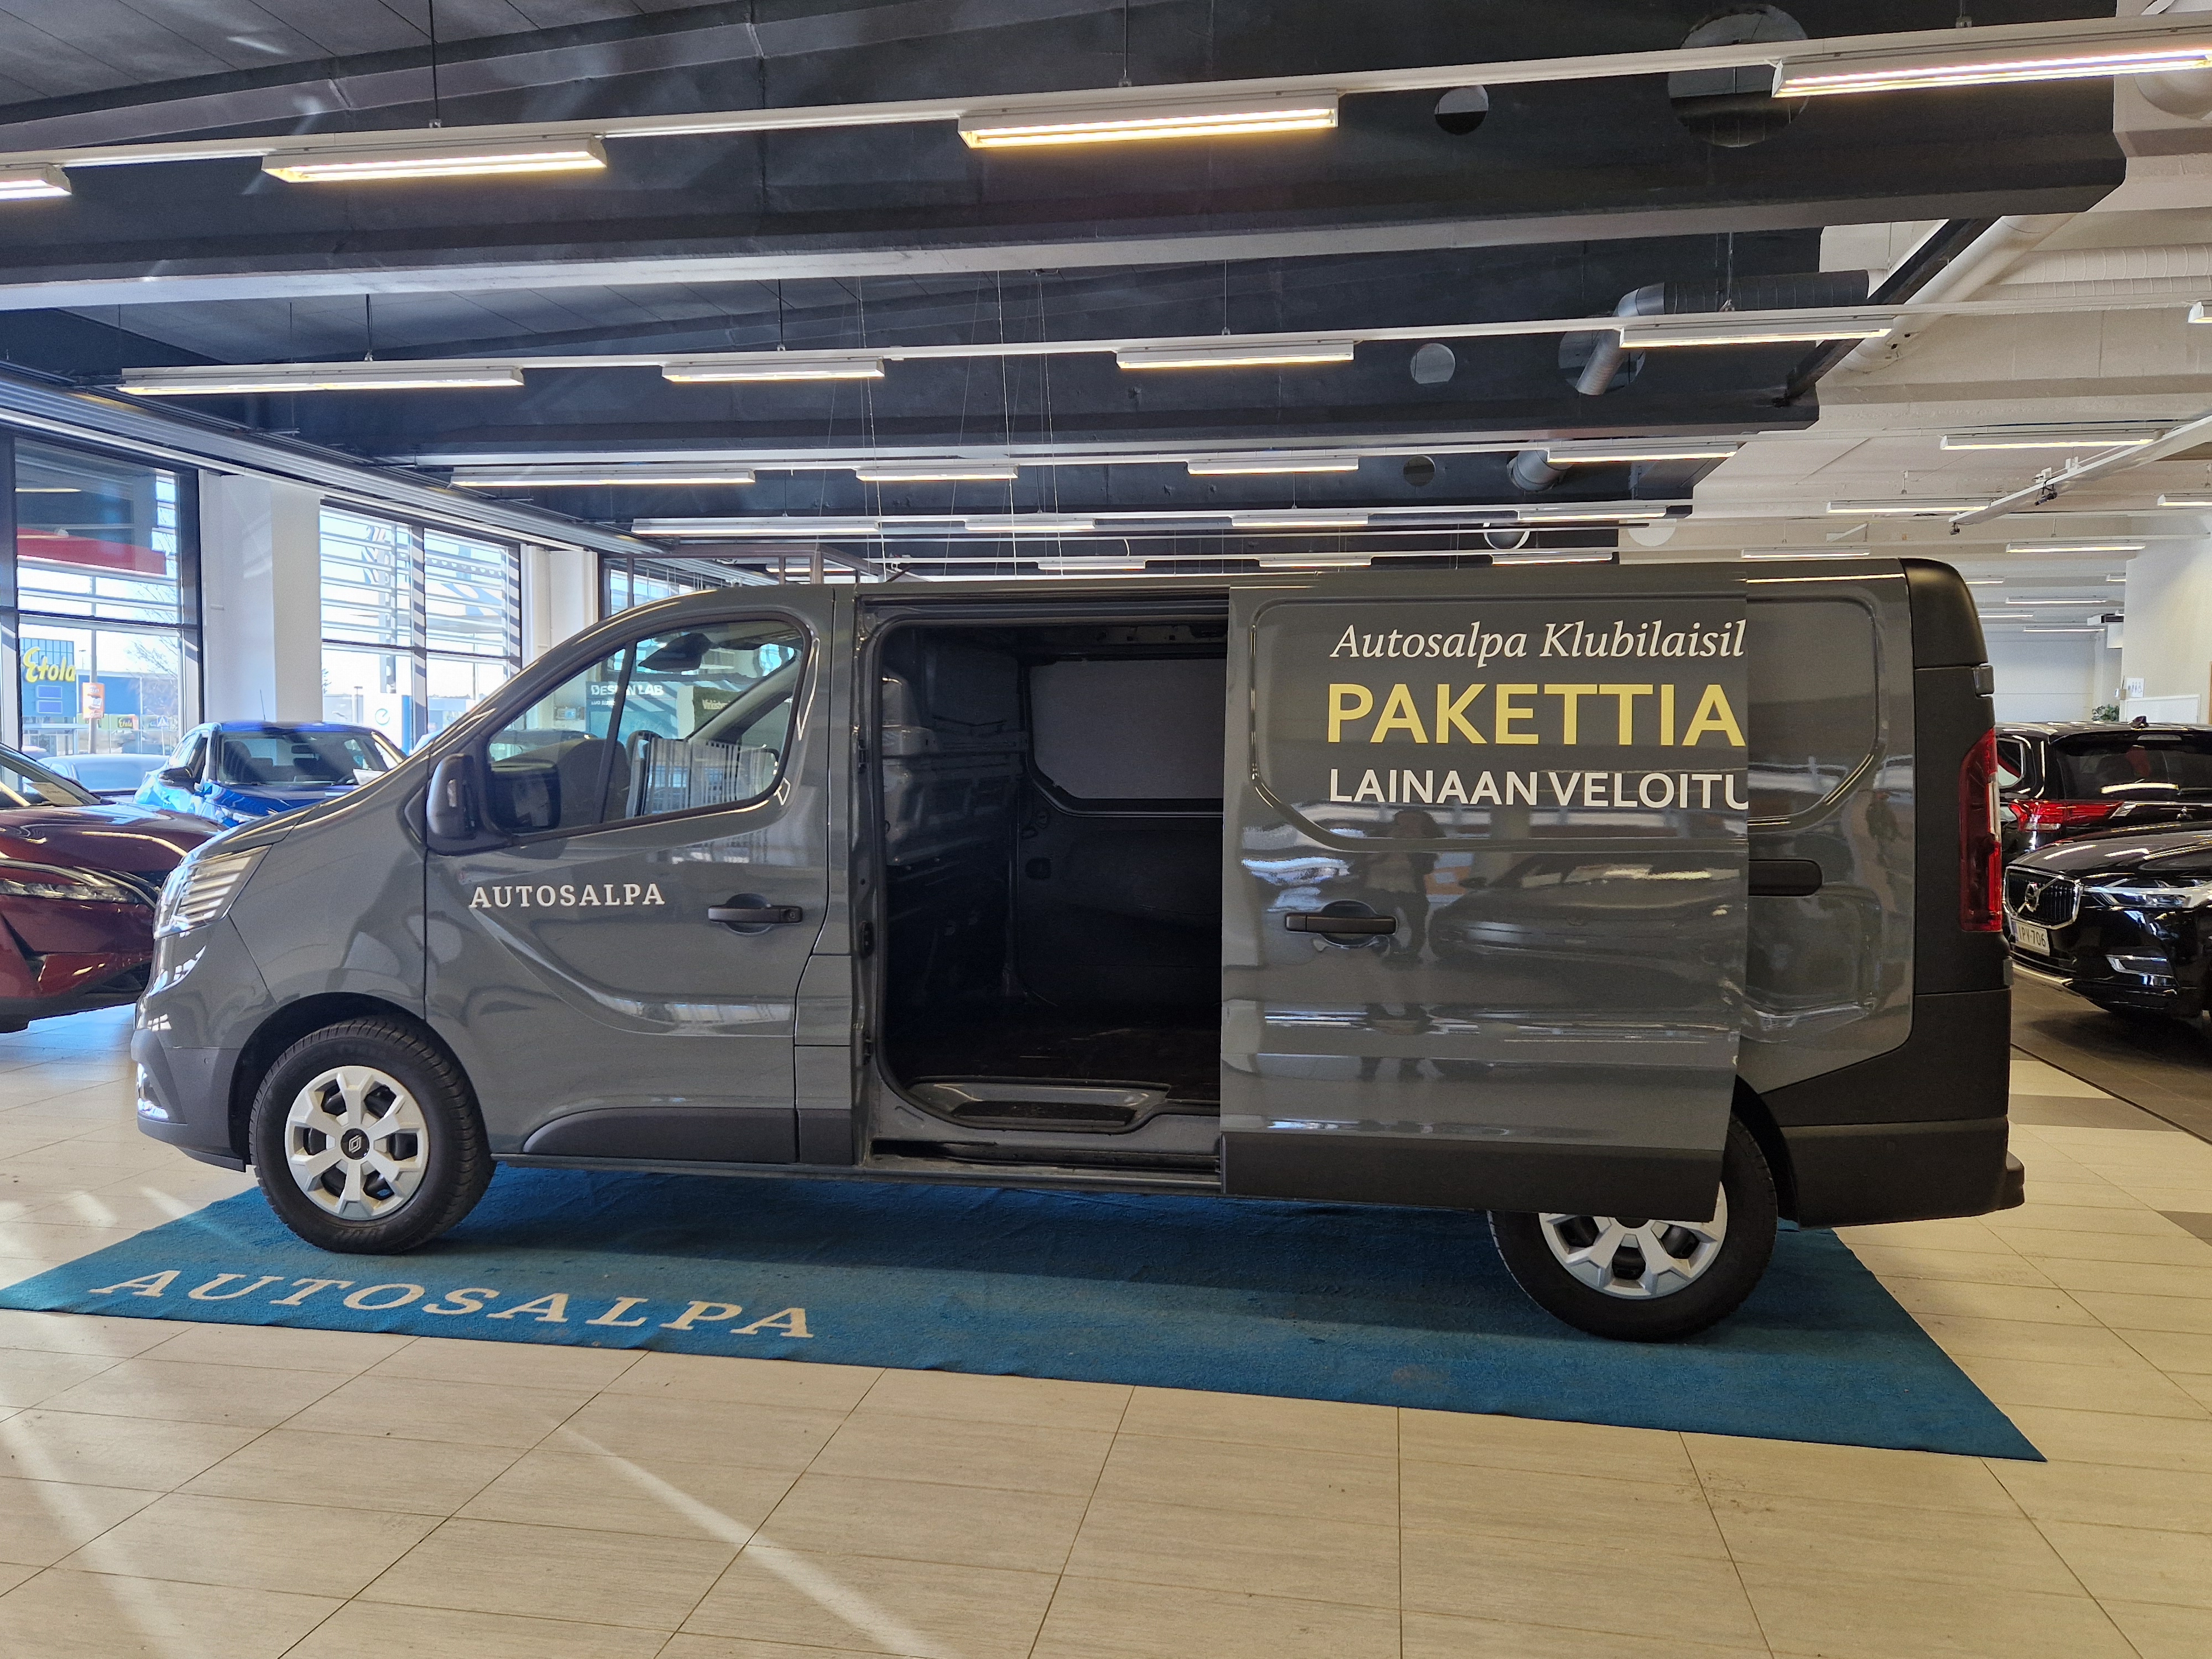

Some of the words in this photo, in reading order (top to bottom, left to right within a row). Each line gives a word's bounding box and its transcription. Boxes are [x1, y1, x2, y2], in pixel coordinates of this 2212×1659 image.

[1329, 620, 1528, 669] Autosalpa
[1538, 619, 1747, 658] Klubilaisil
[23, 646, 76, 683] Etola
[591, 684, 635, 696] DESIN
[638, 684, 664, 696] LAB
[118, 718, 133, 728] Etola
[1327, 683, 1747, 747] PAKETTIA
[1329, 768, 1538, 806] LAINAAN
[1547, 771, 1749, 811] VELOITU
[468, 883, 665, 909] AUTOSALPA
[88, 1269, 815, 1338] AUTOSALPA
